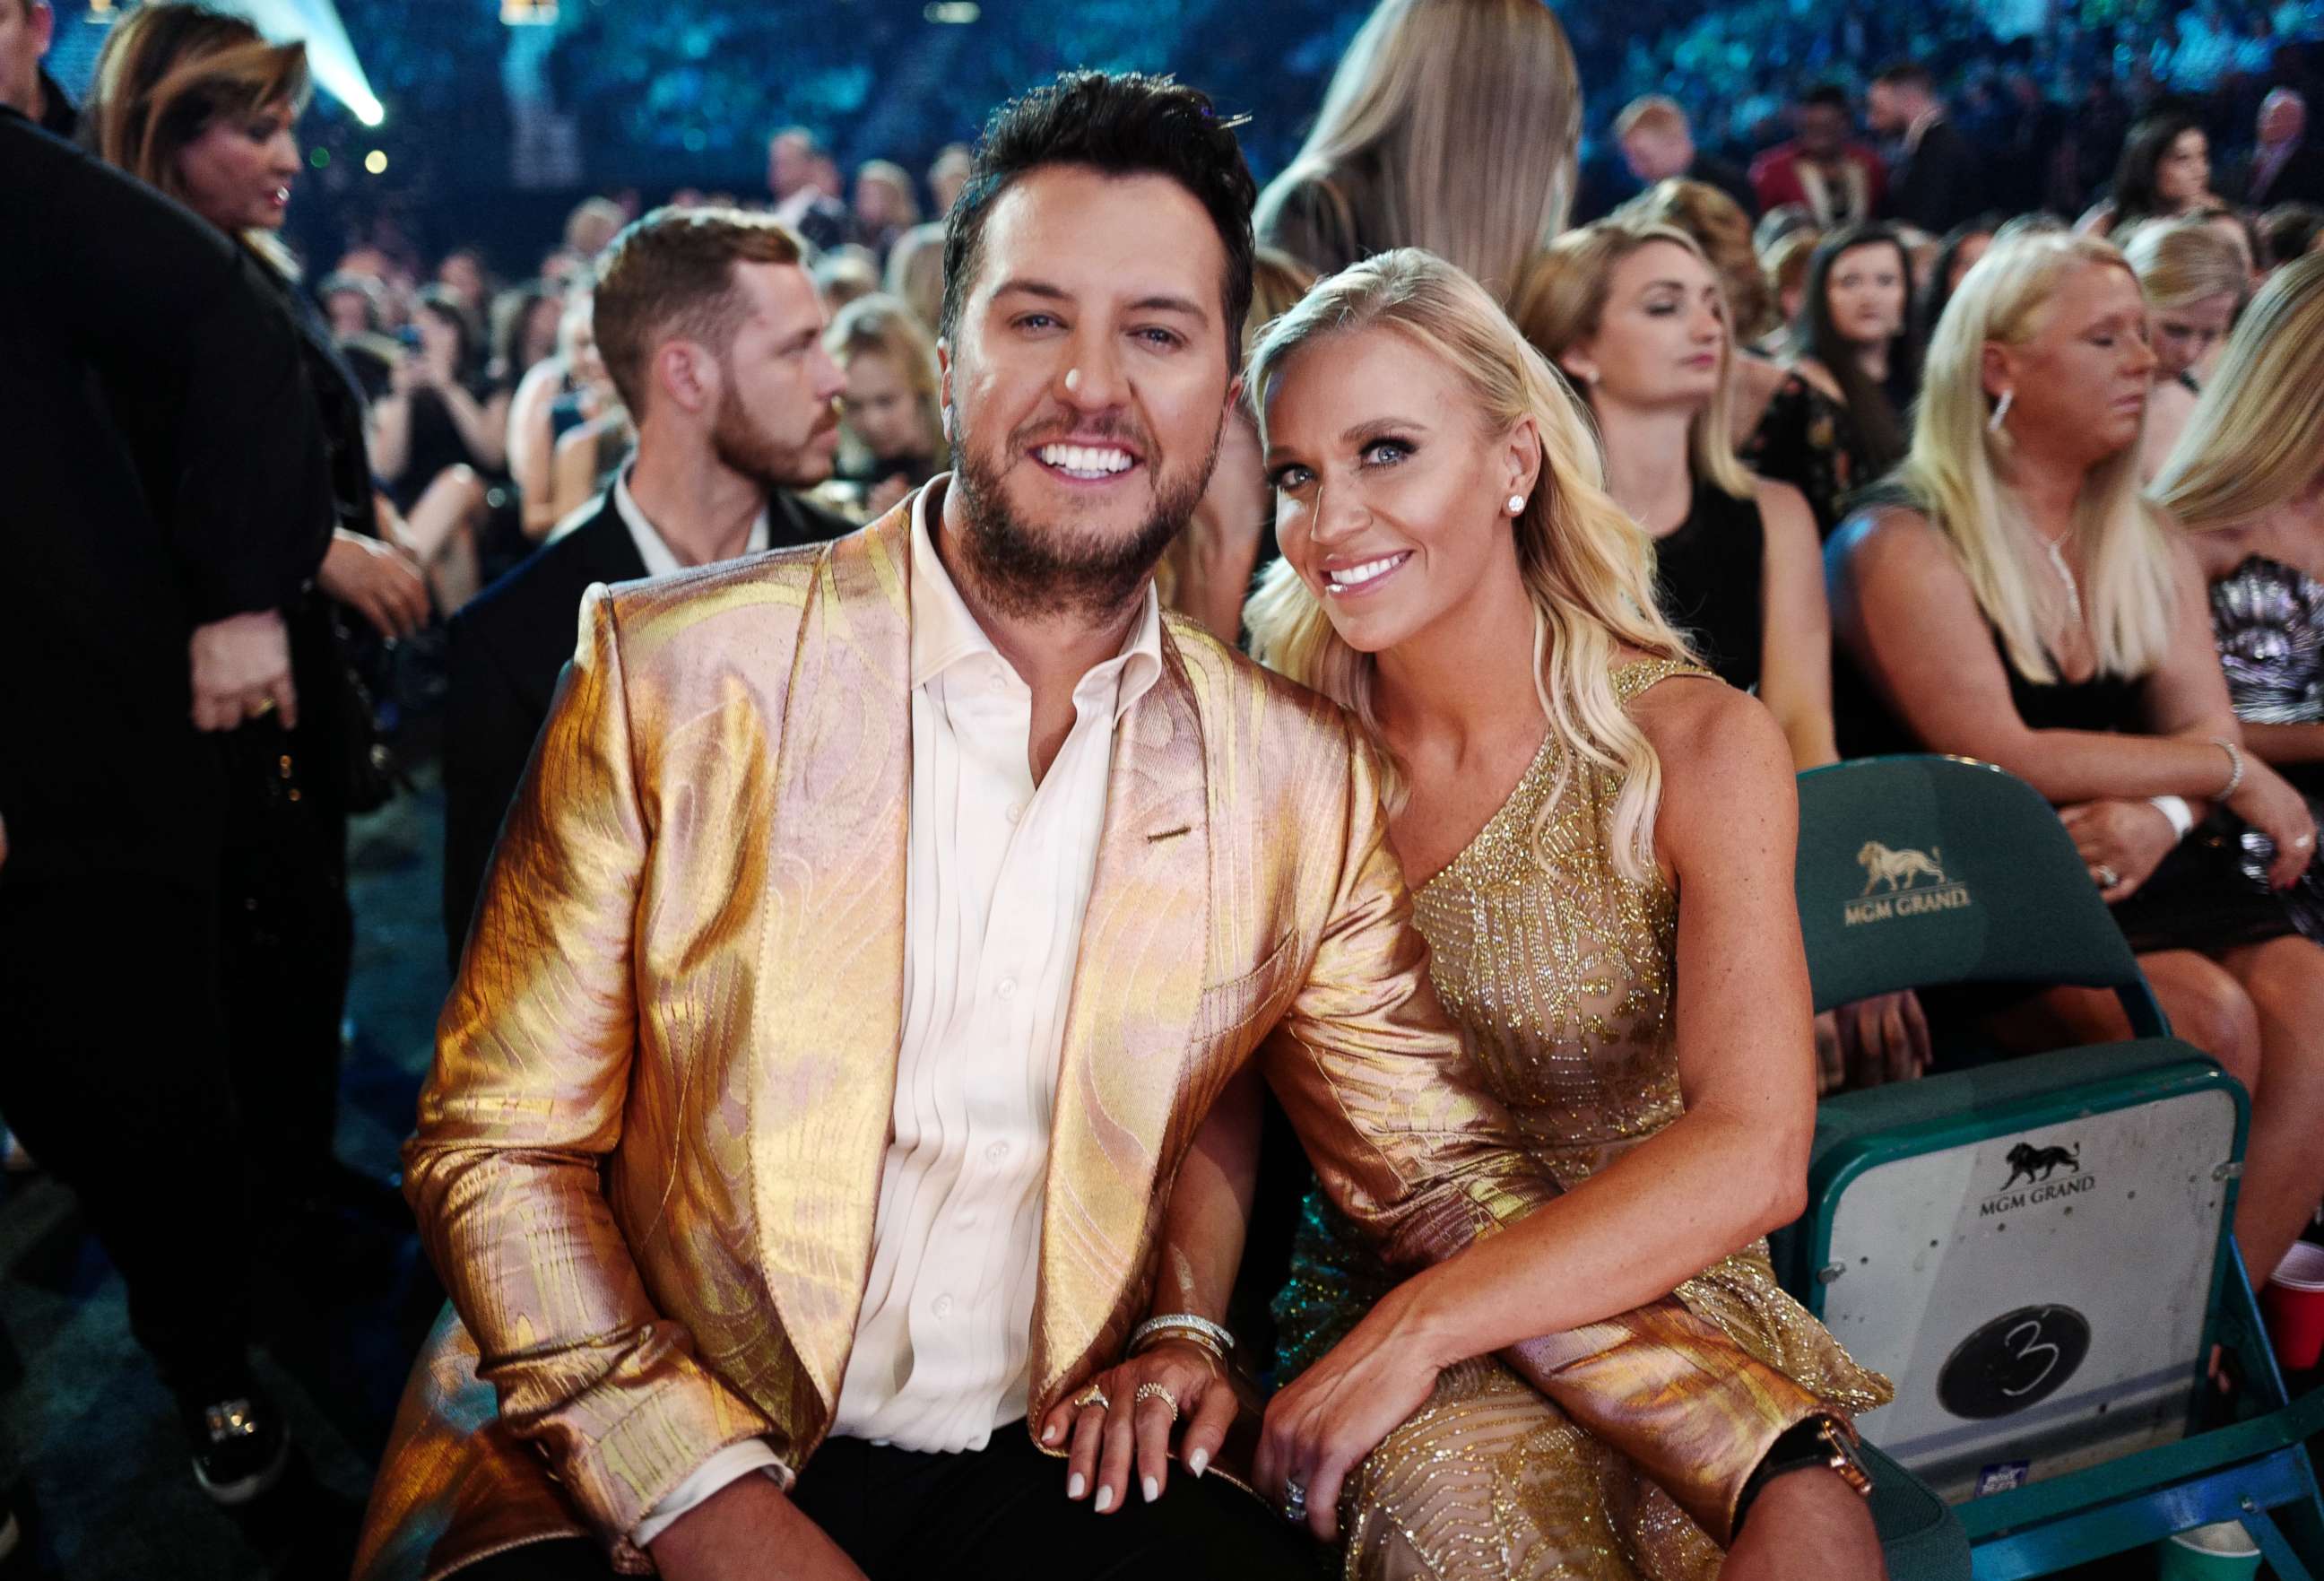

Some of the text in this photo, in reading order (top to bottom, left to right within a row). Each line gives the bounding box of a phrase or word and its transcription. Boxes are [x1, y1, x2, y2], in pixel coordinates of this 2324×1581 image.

[1844, 888, 1968, 926] MGM GRAND
[1980, 1176, 2094, 1217] MGM GRAND
[2003, 1321, 2059, 1396] 3
